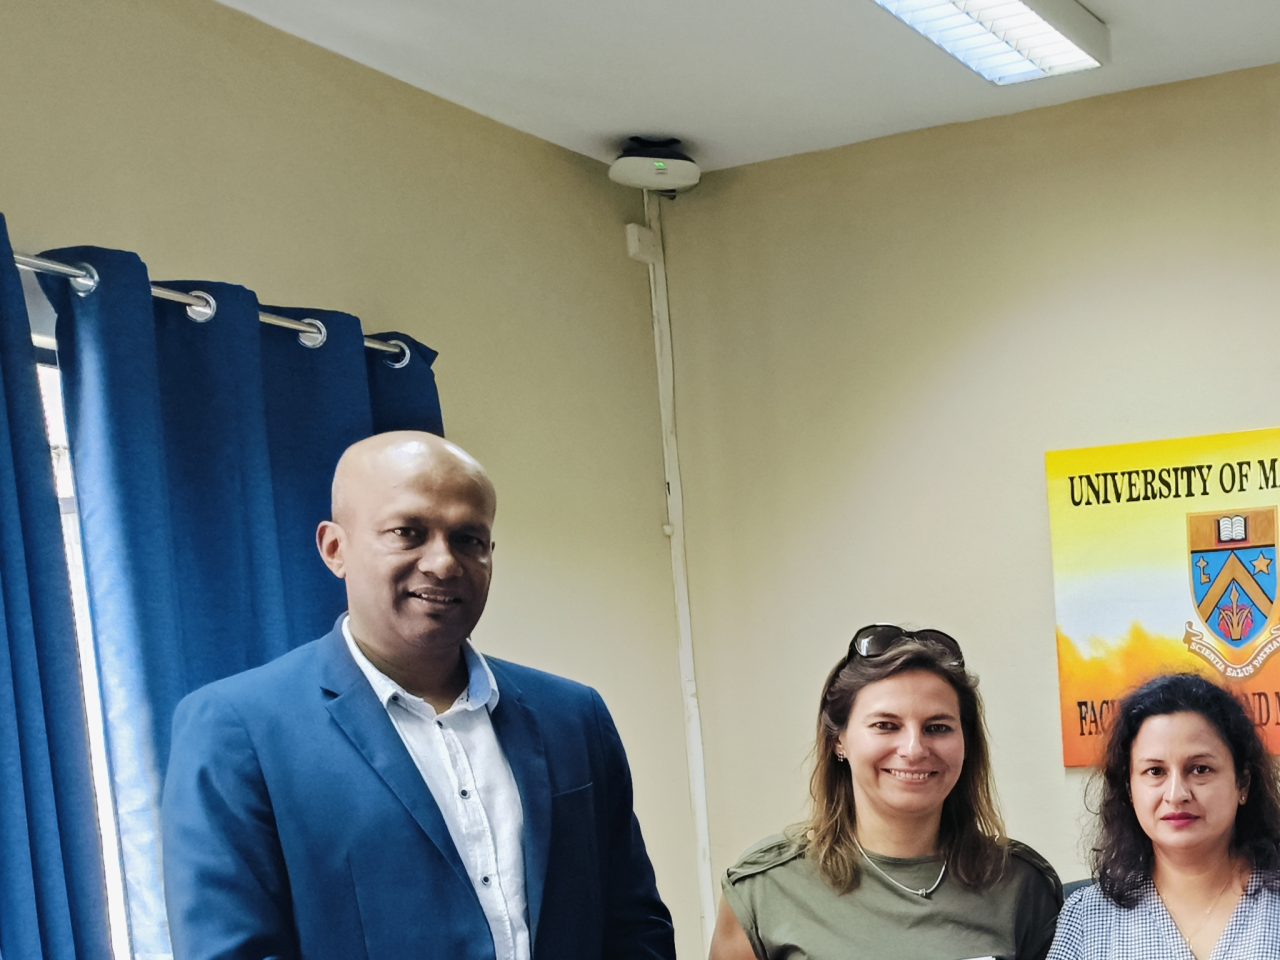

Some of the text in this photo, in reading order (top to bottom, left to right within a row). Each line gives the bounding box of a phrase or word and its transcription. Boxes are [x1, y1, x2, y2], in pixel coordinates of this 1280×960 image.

[1068, 464, 1213, 507] UNIVERSITY
[1219, 461, 1251, 494] OF
[1226, 665, 1255, 678] SALUS
